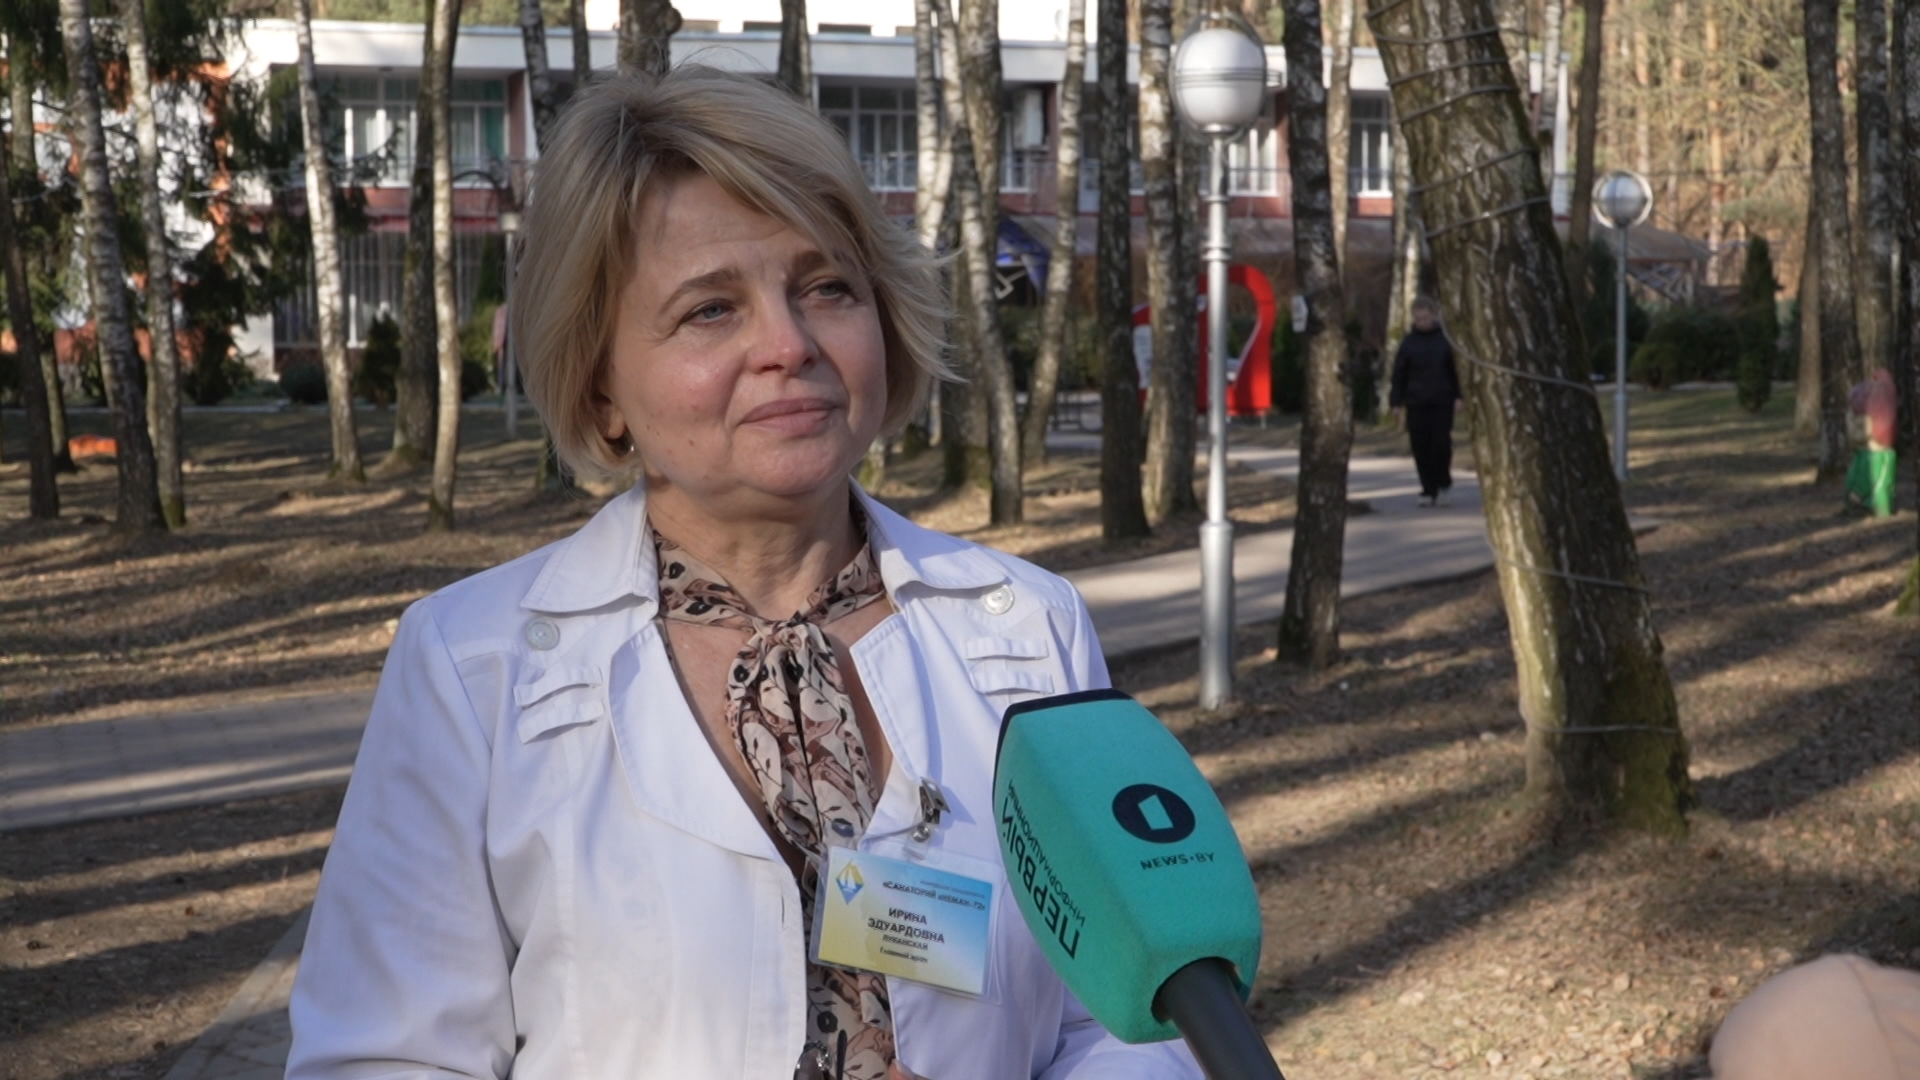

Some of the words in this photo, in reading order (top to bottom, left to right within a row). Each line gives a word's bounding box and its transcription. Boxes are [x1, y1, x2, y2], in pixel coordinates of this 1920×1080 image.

[1002, 797, 1080, 960] ПЕРВЫЙ
[888, 907, 927, 925] ИРИНА
[867, 917, 945, 944] ЭДУАРДОВНА
